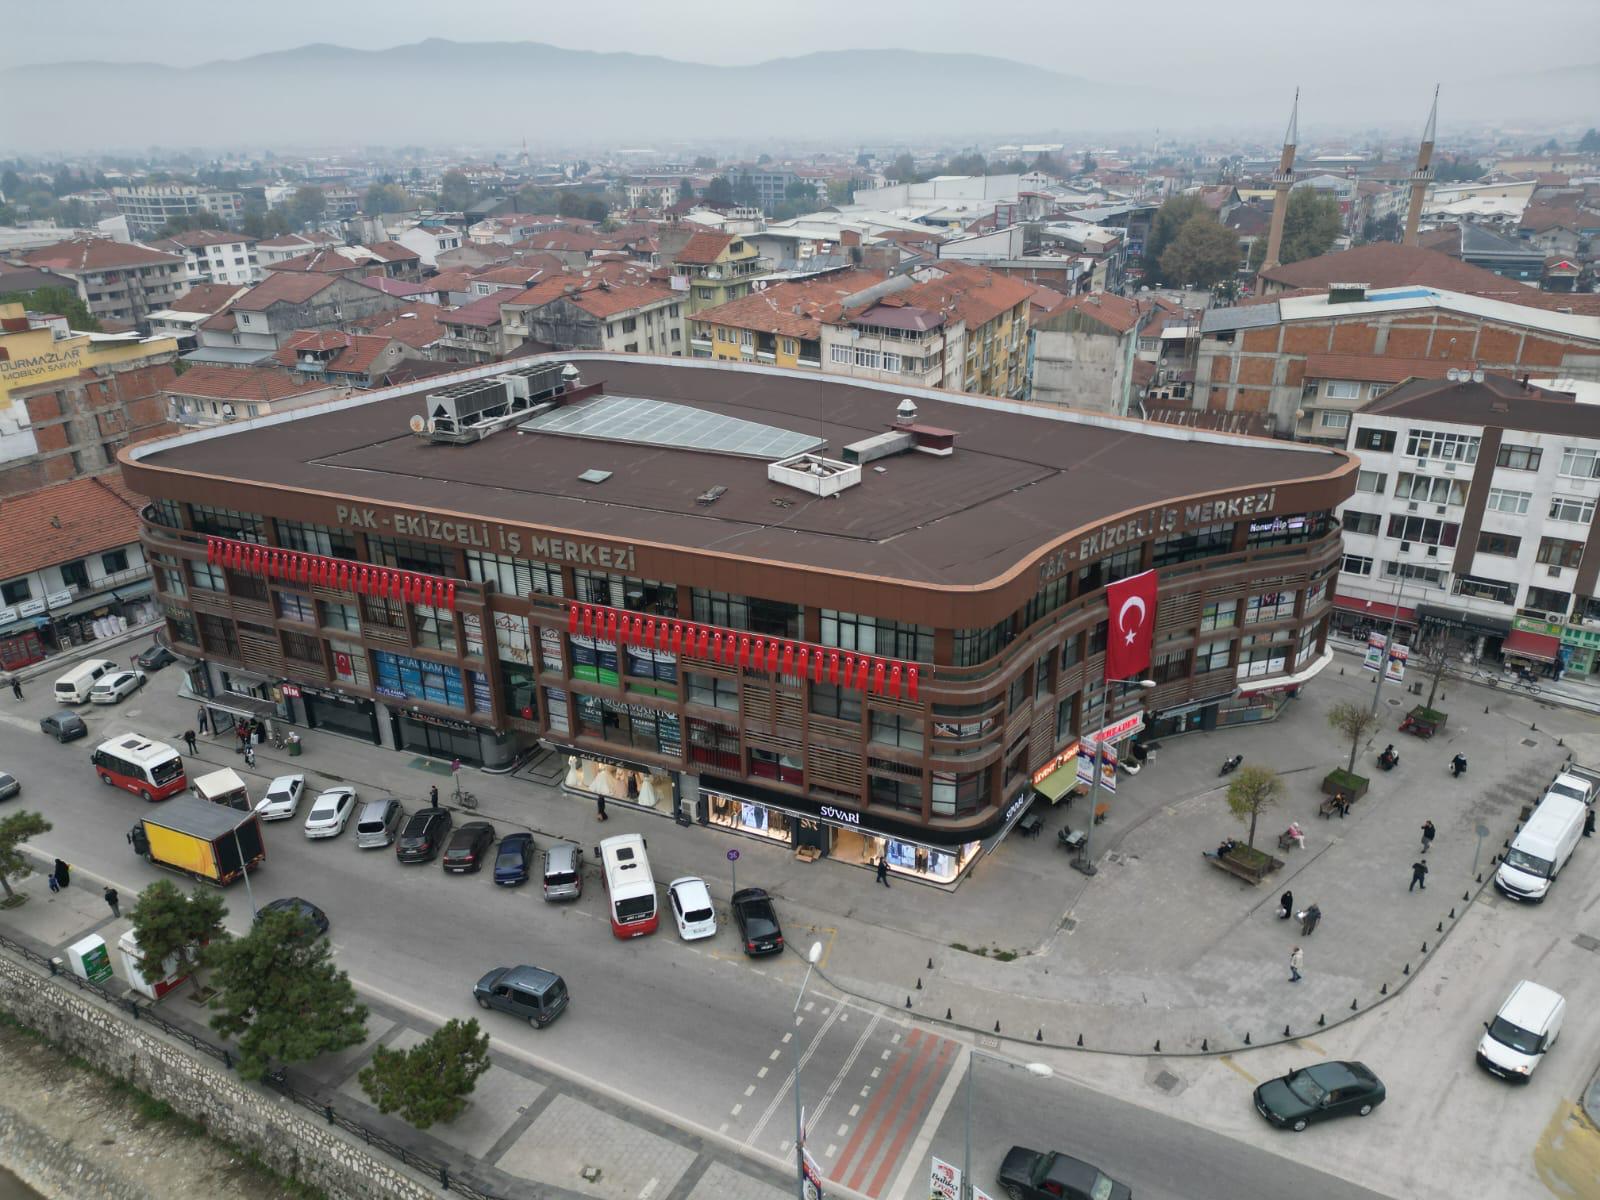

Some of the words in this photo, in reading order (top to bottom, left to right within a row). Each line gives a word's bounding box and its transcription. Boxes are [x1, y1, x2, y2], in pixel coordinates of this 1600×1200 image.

[0, 349, 80, 372] DURMAZLAR
[1184, 487, 1277, 523] MERKEZİ
[336, 504, 378, 529] PAK
[394, 512, 490, 548] EKİZCELİ
[497, 525, 521, 555] İŞ
[531, 534, 636, 572] MERKEZİ
[282, 685, 300, 698] BİM
[820, 805, 860, 825] SÜVARİ
